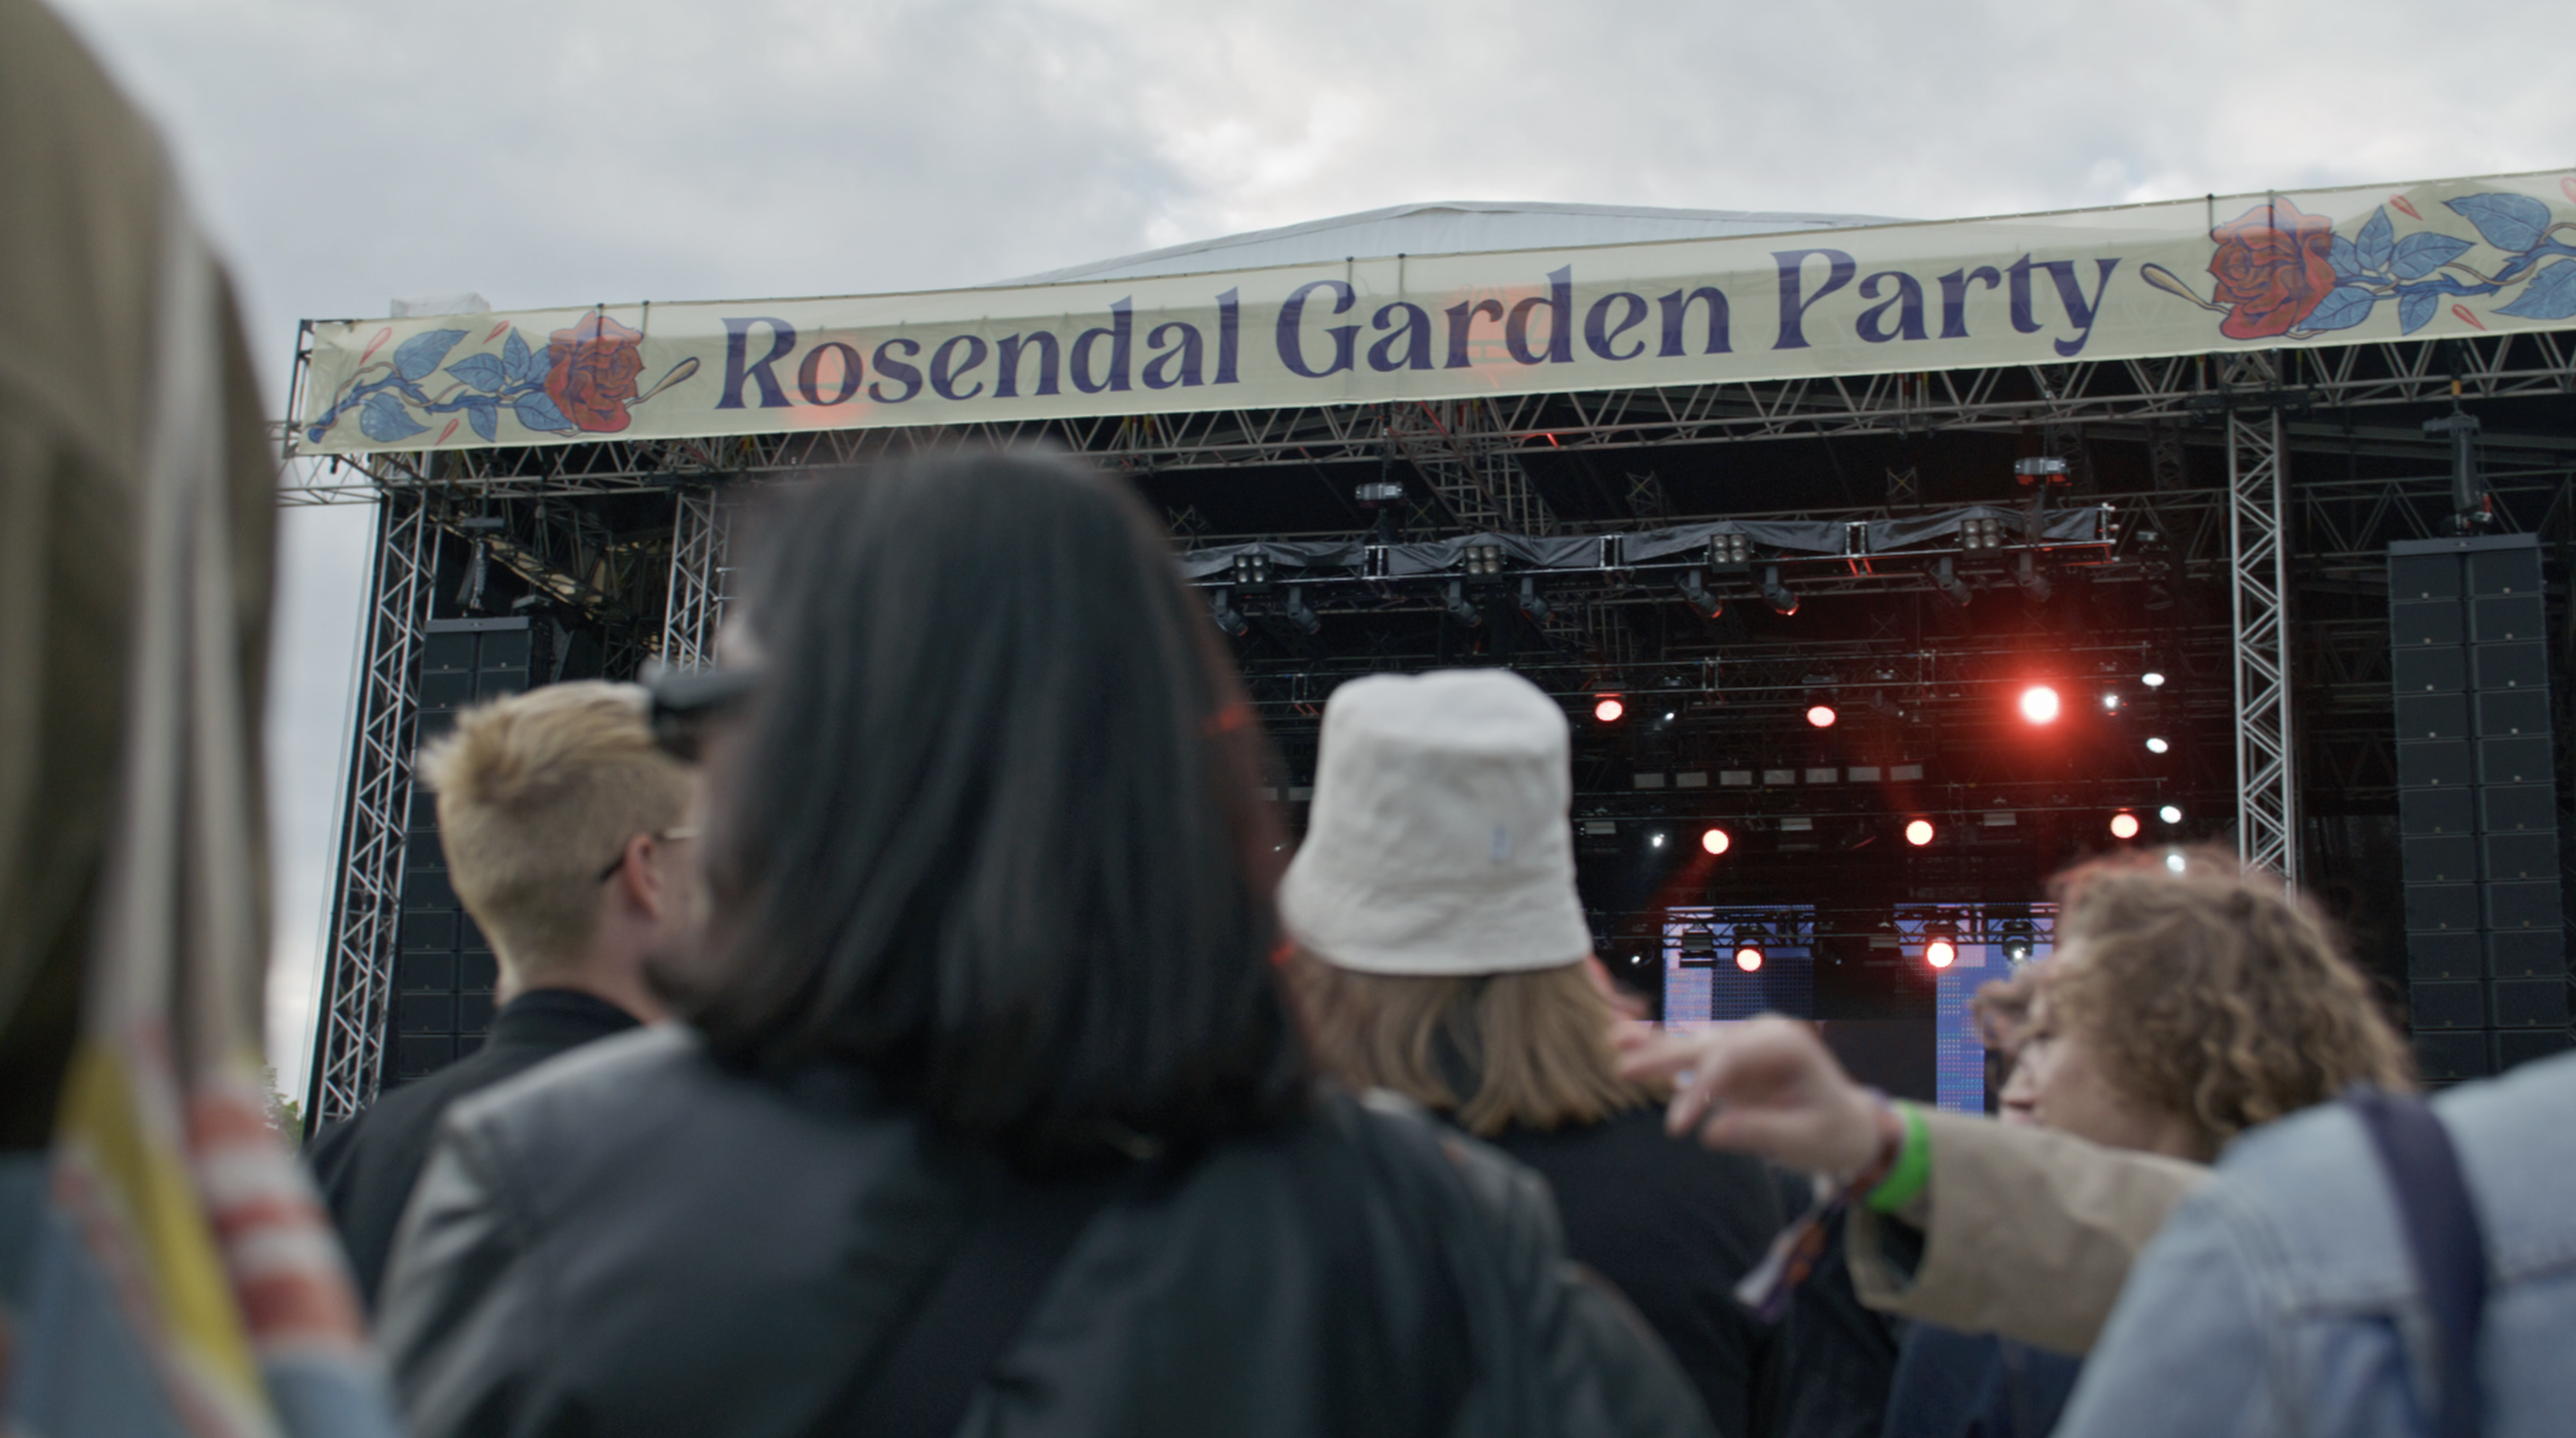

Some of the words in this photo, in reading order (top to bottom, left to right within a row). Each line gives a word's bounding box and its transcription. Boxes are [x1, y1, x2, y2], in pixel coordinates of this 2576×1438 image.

[715, 286, 1241, 410] Rosendal
[1276, 265, 1734, 378] Garden
[1770, 248, 2123, 357] Party
